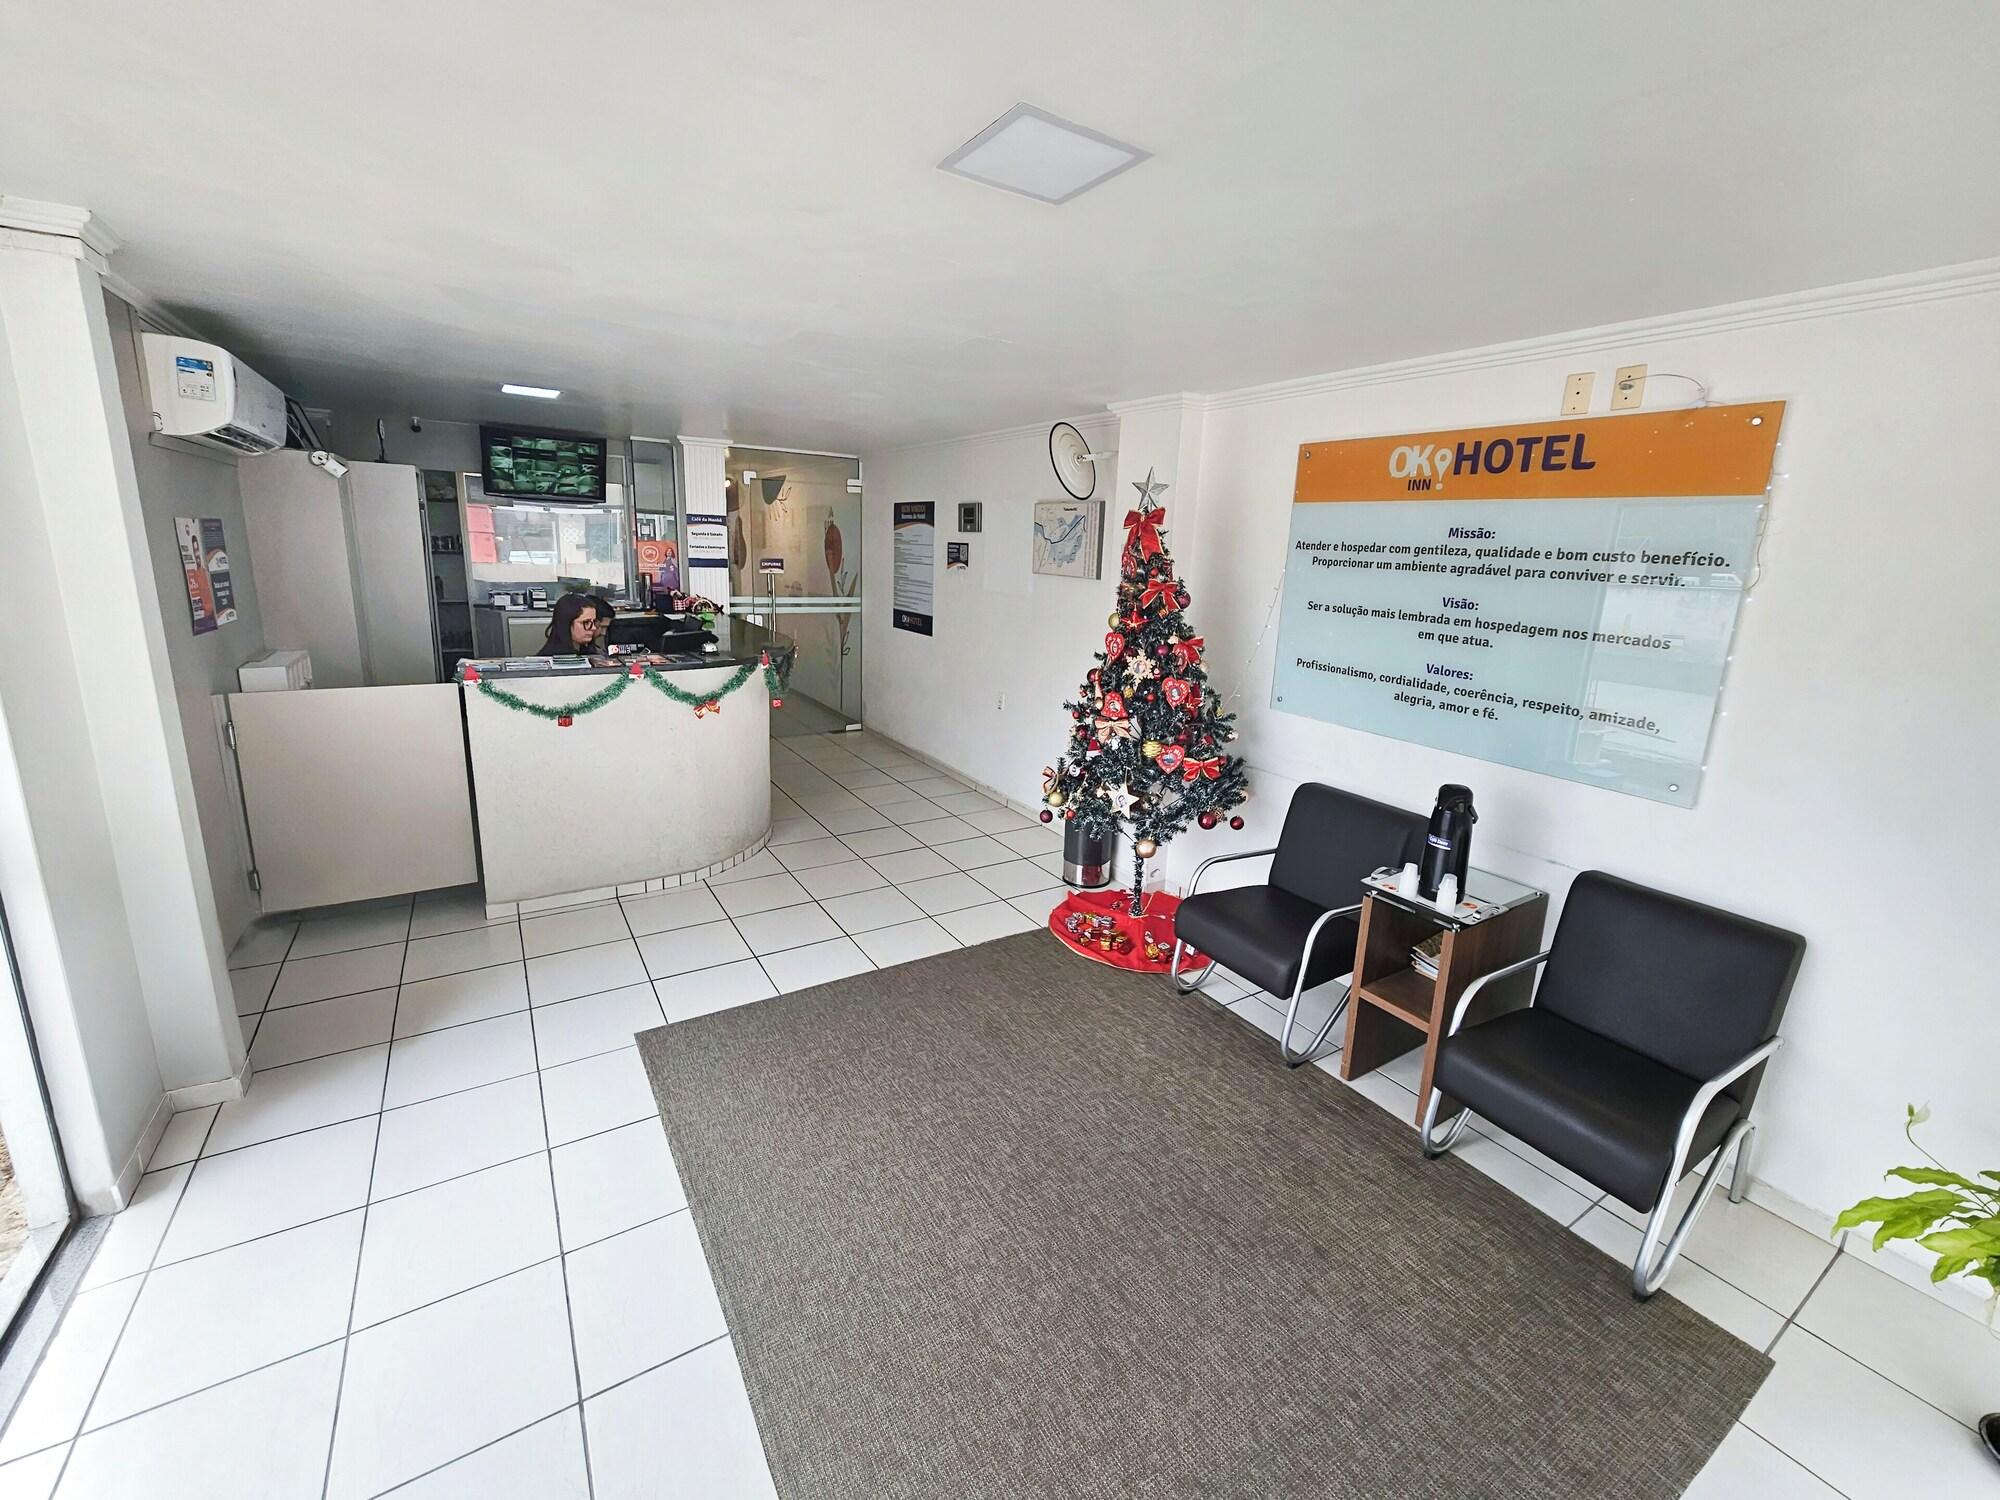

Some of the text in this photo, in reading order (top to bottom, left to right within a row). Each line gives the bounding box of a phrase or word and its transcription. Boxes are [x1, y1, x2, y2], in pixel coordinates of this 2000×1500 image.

[1453, 433, 1596, 475] HOTEL
[1407, 478, 1432, 491] INN
[1448, 527, 1496, 539] Missão:
[1295, 540, 1730, 567] Atender e hospedar com gentileza, qualidade e bom custo benefício.
[1312, 556, 1686, 587] Proporcionar um ambiente agradável para conviver e servir.
[1442, 597, 1479, 611] Visão:
[1307, 601, 1323, 610] Ser
[1332, 603, 1369, 617] solução
[1371, 608, 1396, 619] mais
[1398, 609, 1451, 625] lembrada
[1453, 618, 1471, 627] em
[1474, 618, 1558, 638] hospedagem
[1562, 629, 1588, 641] nos
[1592, 632, 1671, 650] mercados
[1418, 631, 1493, 648] em que atua.
[1426, 663, 1473, 681] Valores:
[1296, 657, 1660, 734] Profissionalismo, cordialidade, coerência, respeito, amizade,
[1393, 691, 1499, 721] alegria, amor e fé.
